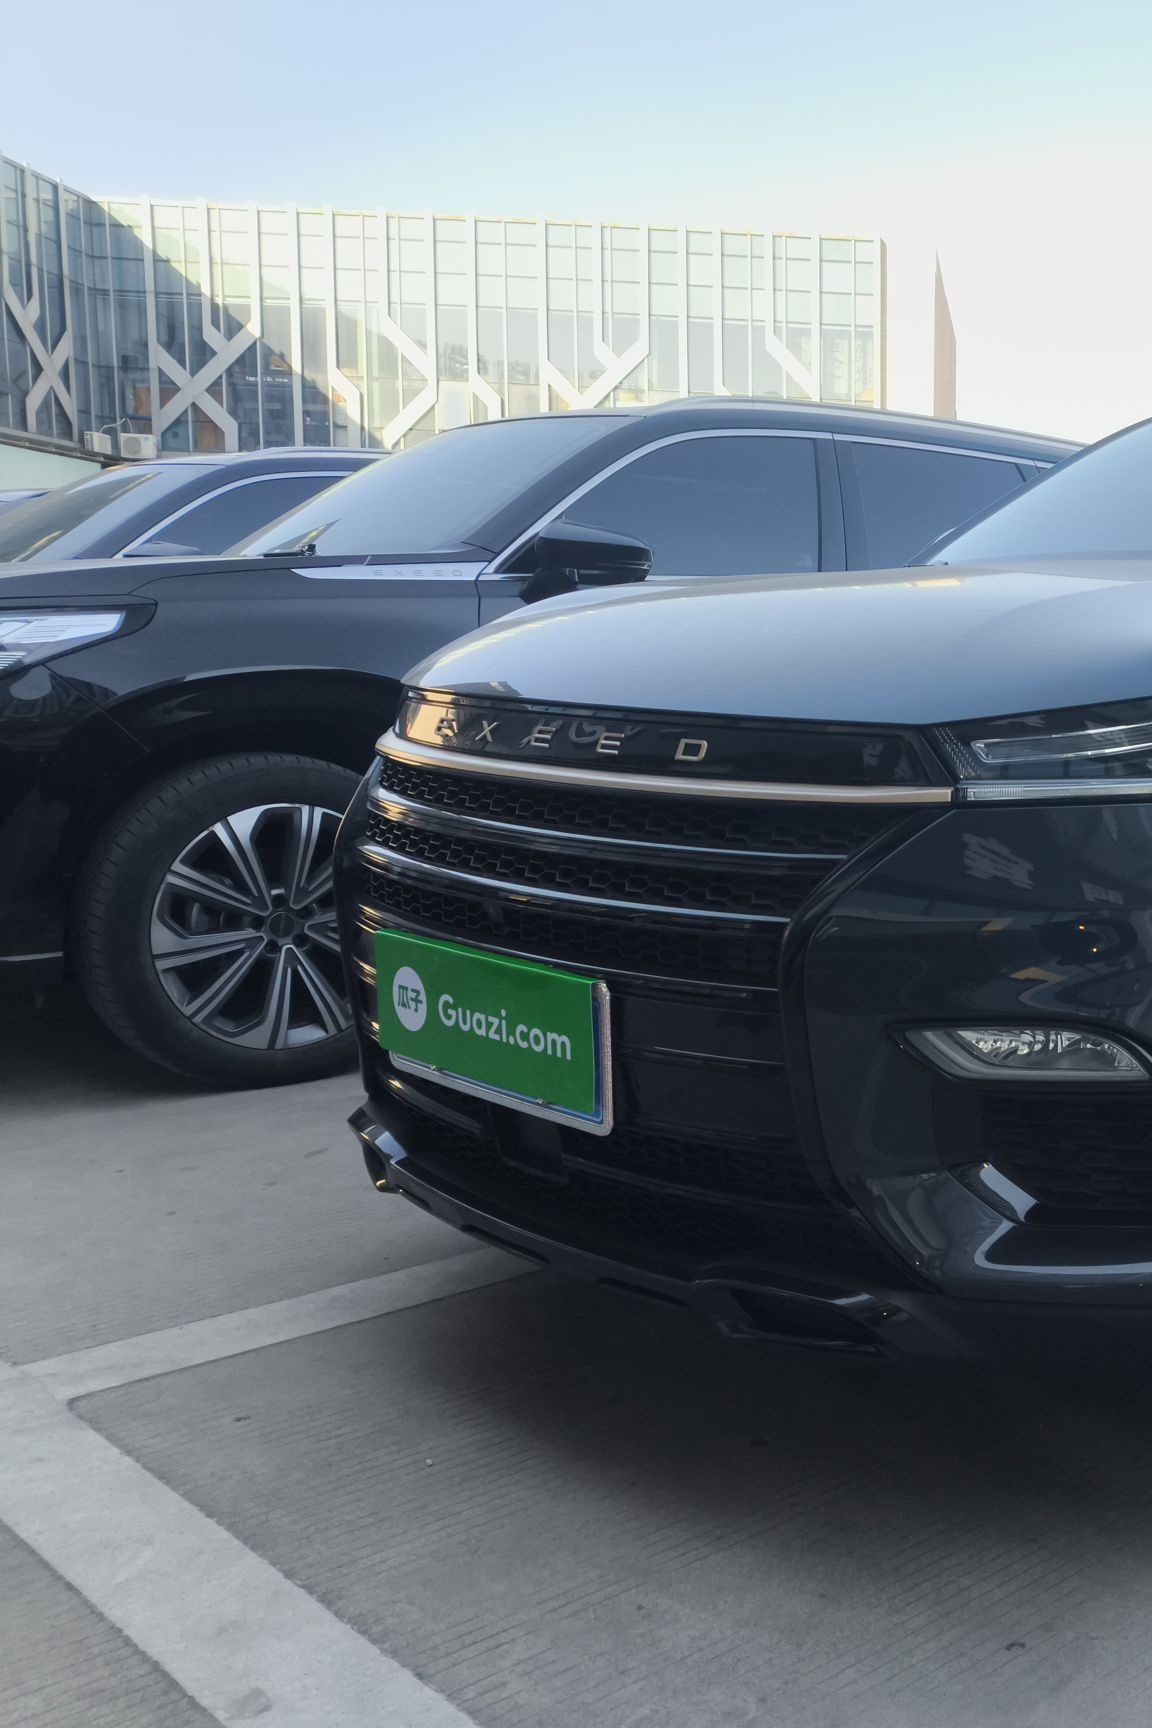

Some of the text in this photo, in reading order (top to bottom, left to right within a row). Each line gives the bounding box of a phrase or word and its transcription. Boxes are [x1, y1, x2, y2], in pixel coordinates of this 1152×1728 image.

[372, 569, 463, 578] EXEED
[434, 715, 708, 763] EXEED
[397, 984, 423, 1013] 瓜子
[438, 993, 572, 1061] Guazi.com
